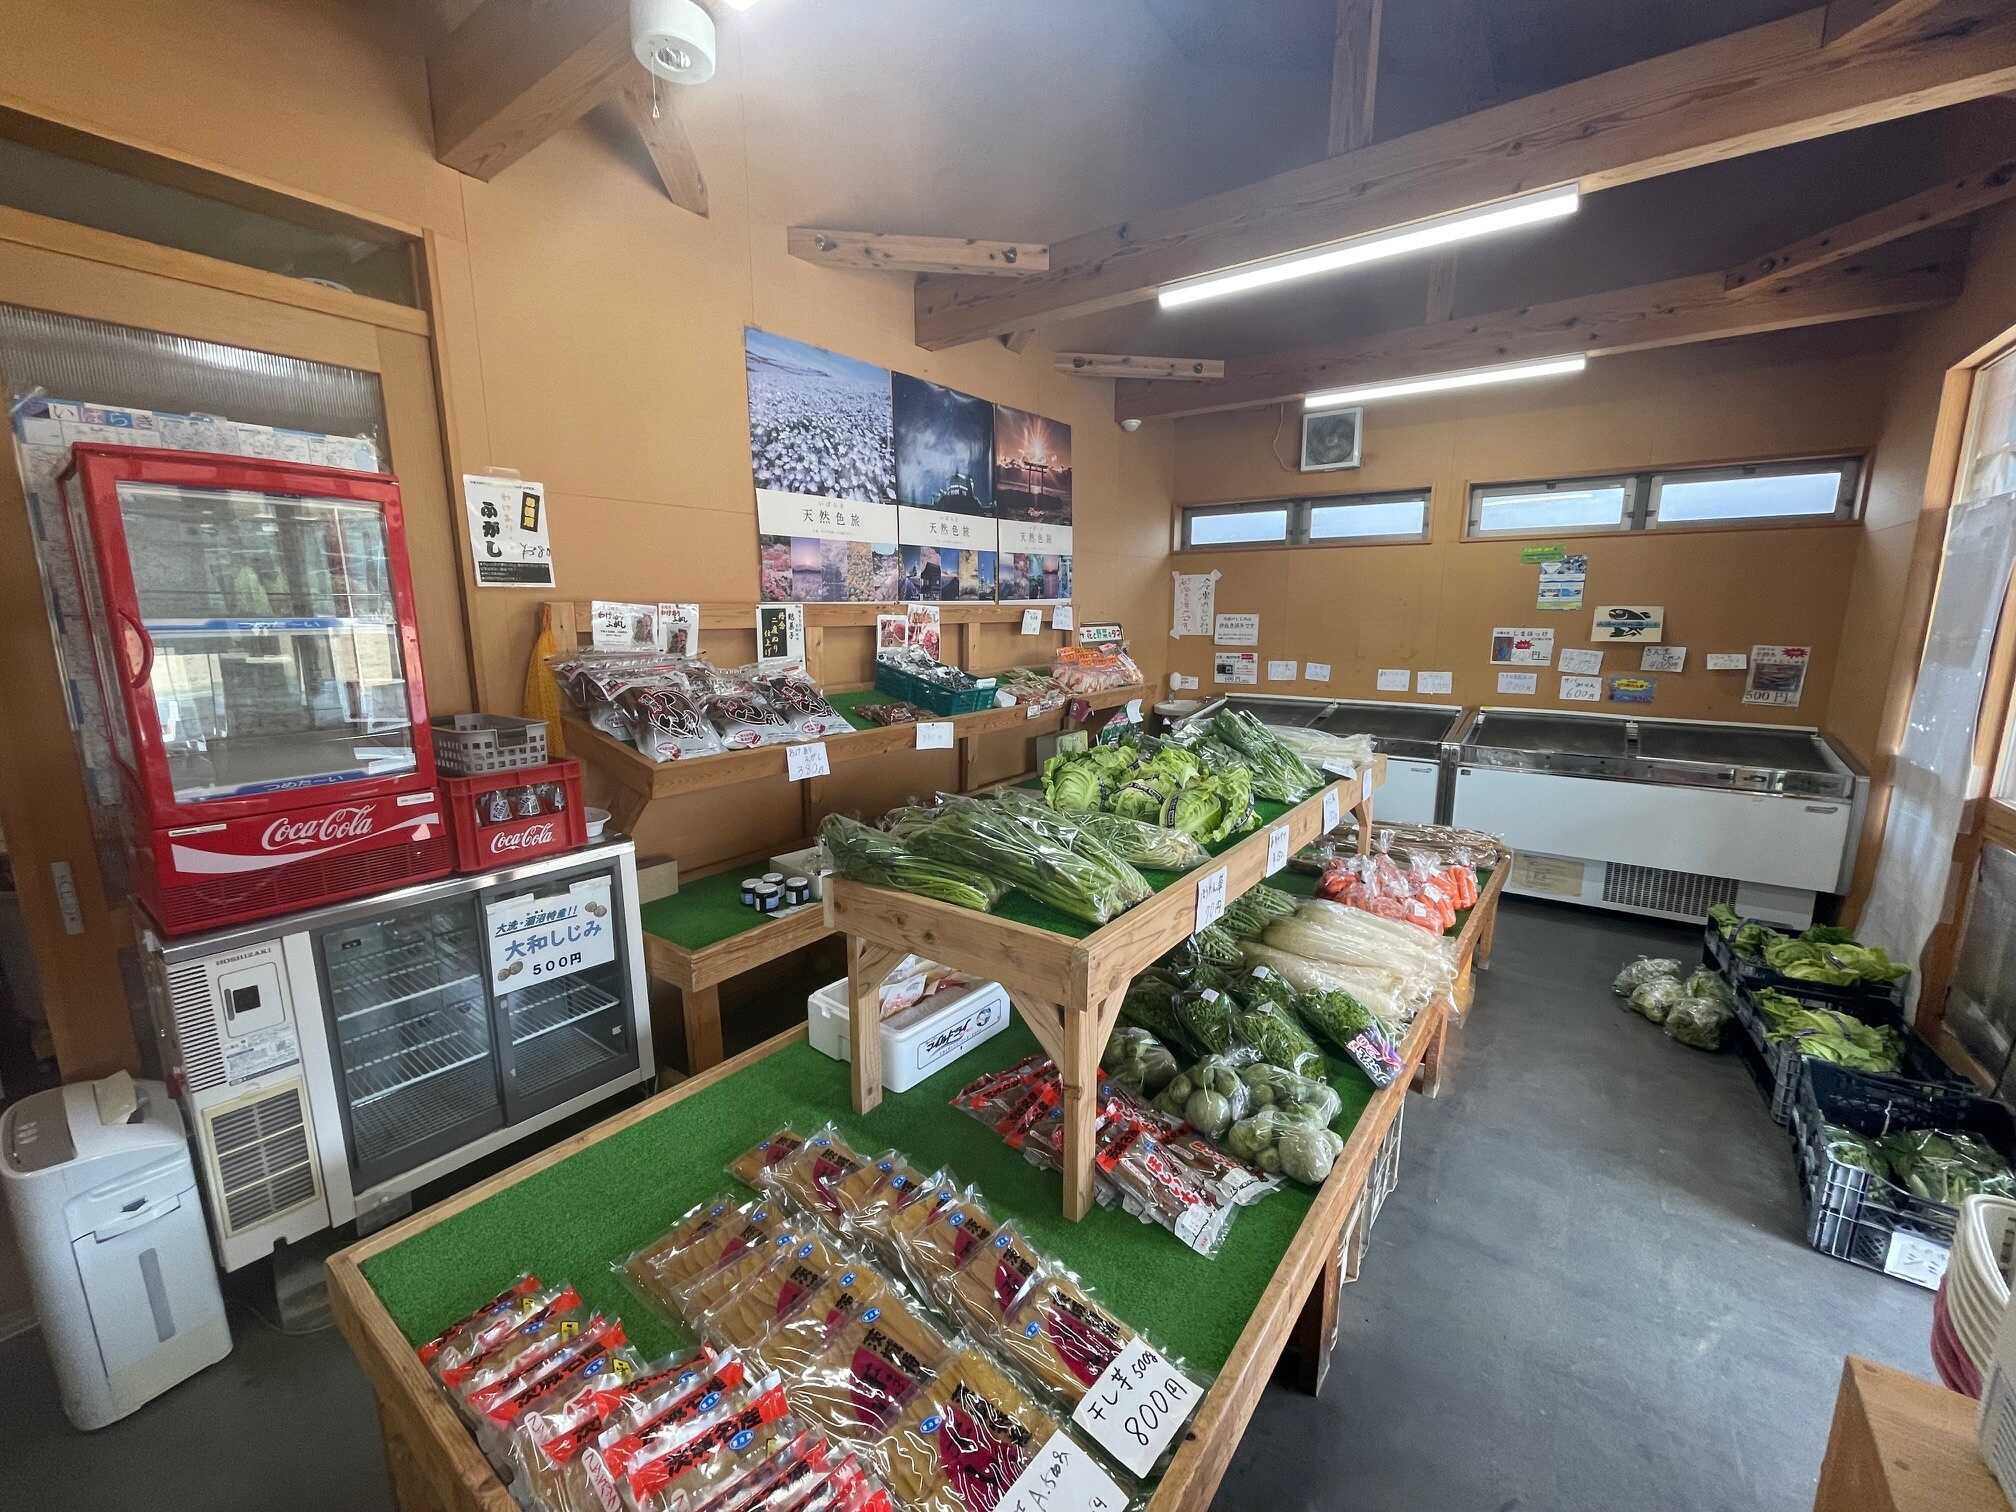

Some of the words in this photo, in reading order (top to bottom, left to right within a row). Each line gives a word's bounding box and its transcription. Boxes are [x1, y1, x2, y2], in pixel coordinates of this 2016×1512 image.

[802, 508, 862, 528] 天然色旅
[928, 521, 971, 538] 天然色旅
[263, 804, 377, 851] Coca-Cola
[490, 822, 554, 854] Coca-Cola
[216, 947, 272, 966] HOSHIZAKI
[504, 919, 602, 962] 大和しじみ
[532, 951, 582, 976] 500円
[1087, 1366, 1134, 1421] 干し芋
[1131, 1350, 1159, 1379] 500g
[1124, 1377, 1188, 1446] 800円
